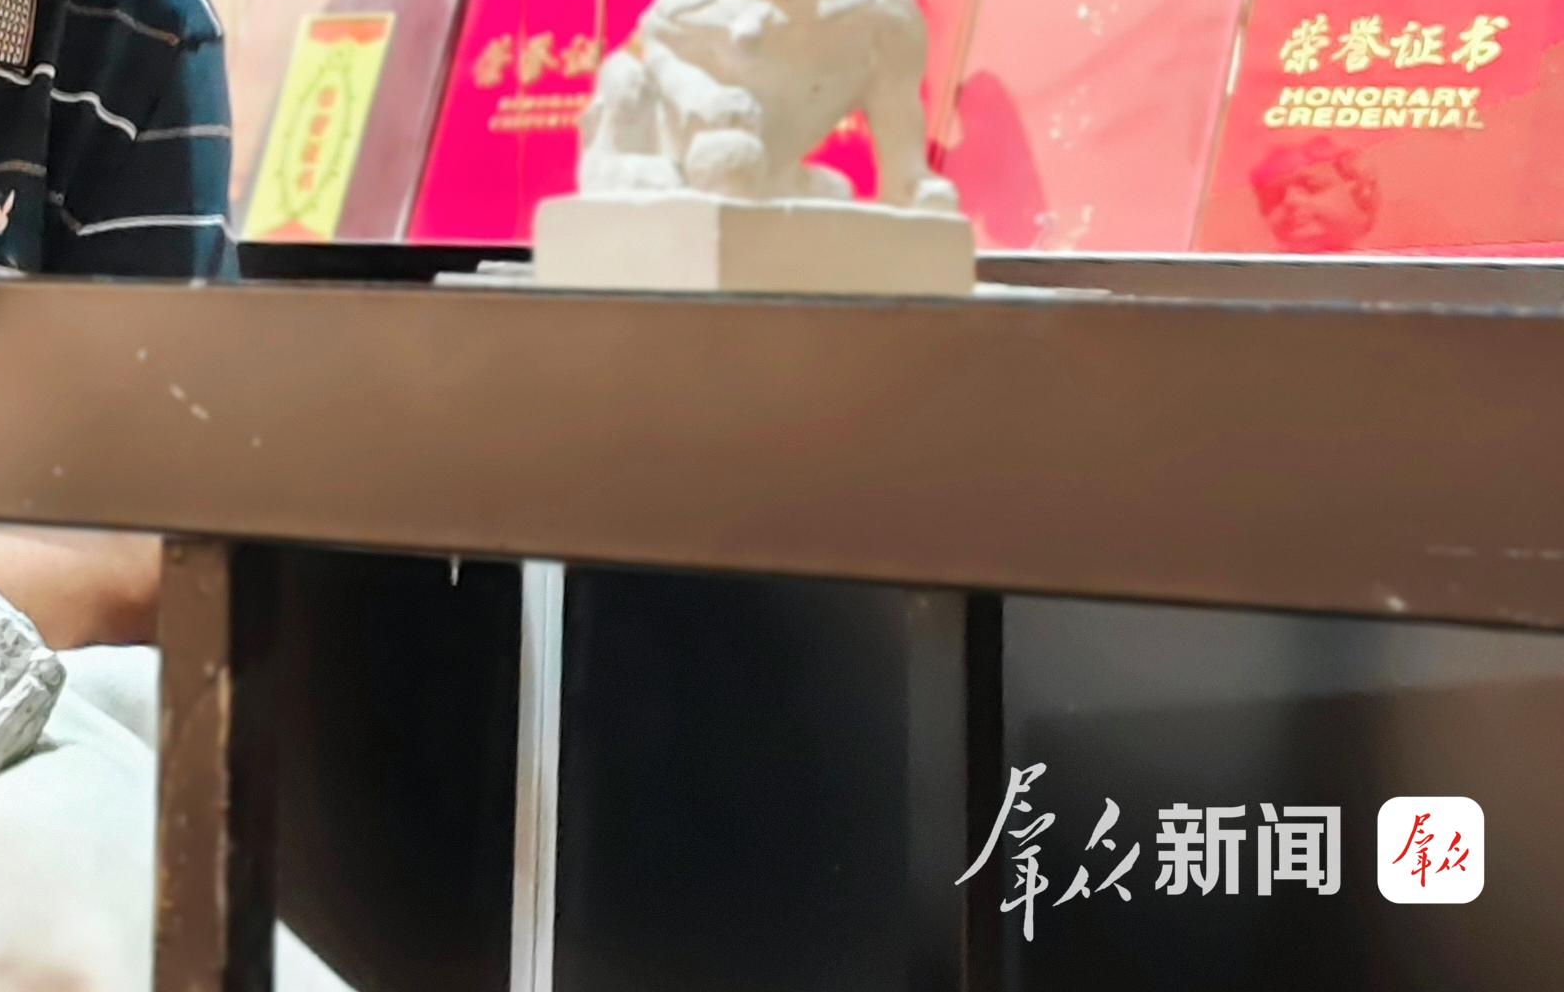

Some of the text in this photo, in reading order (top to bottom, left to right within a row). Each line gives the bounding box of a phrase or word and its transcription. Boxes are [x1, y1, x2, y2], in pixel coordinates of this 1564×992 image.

[1279, 12, 1510, 75] 荣誉证书
[1279, 86, 1481, 107] HONORARY
[1264, 106, 1485, 129] CREDENTIAL
